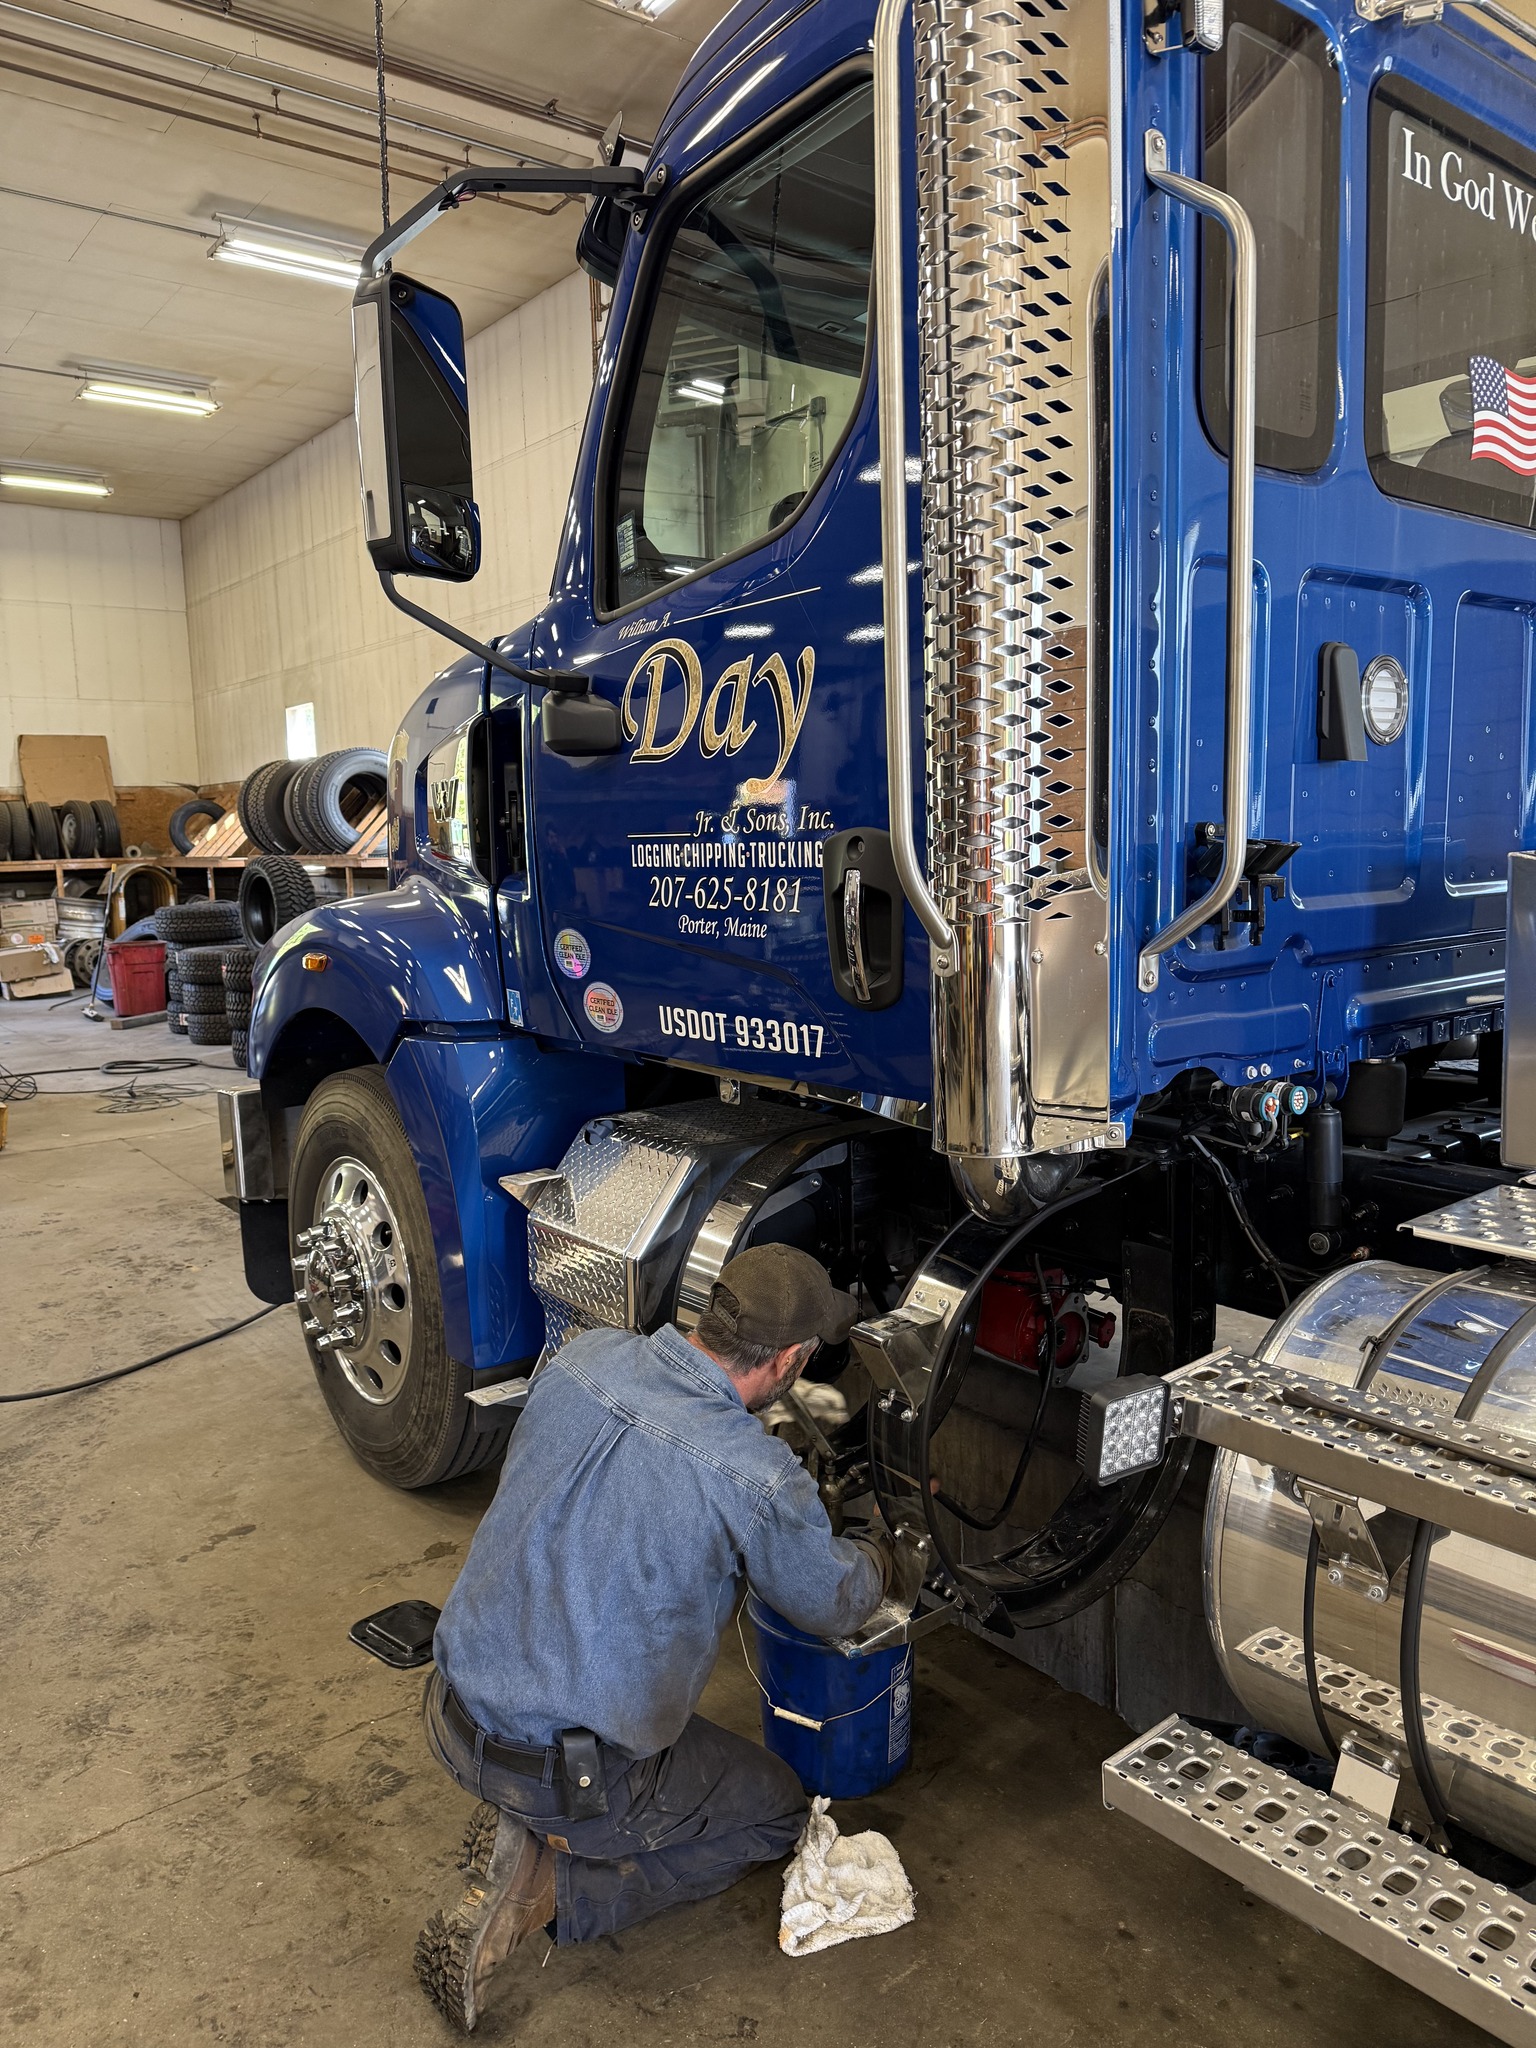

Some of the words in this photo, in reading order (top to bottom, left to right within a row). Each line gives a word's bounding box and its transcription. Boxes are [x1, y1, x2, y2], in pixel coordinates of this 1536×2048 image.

[1402, 127, 1432, 190] In
[1440, 151, 1496, 220] God
[618, 617, 658, 640] William
[621, 638, 815, 795] Day
[693, 810, 714, 837] Jr.
[721, 806, 740, 834] &
[742, 808, 790, 836] Sons,
[798, 805, 835, 831] Inc.
[649, 875, 802, 914] 207-625-8181
[678, 914, 720, 939] Porter,
[724, 916, 768, 938] Maine
[589, 1005, 605, 1014] CLEAN
[606, 1008, 618, 1016] IDLE
[590, 997, 615, 1007] CERTIFIED
[658, 1005, 727, 1044] USDOT
[734, 1015, 824, 1058] 933017
